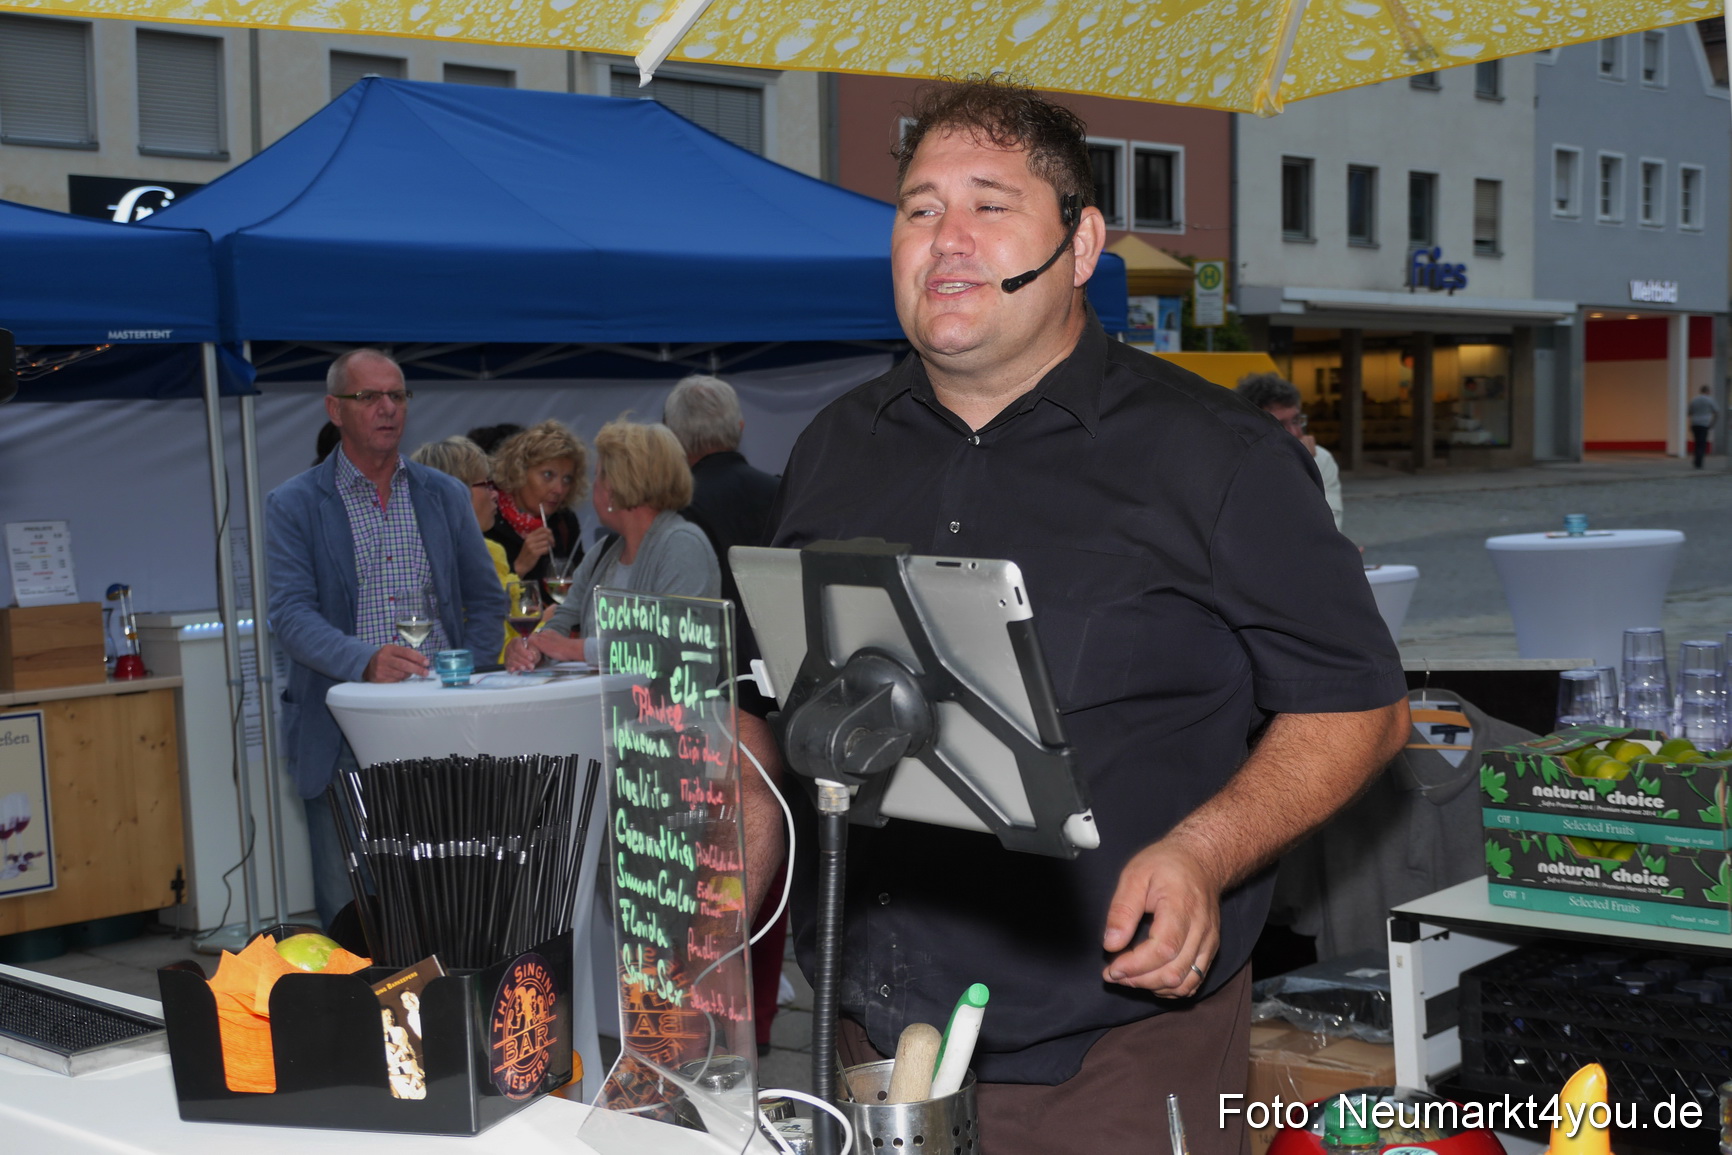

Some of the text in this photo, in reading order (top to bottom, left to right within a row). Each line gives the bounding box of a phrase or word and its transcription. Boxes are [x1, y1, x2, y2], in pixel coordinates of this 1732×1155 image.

[1411, 246, 1468, 290] fries
[108, 330, 173, 340] MASTERTENT
[598, 596, 670, 638] Cocktails
[613, 706, 671, 760] Ipanema
[1532, 785, 1666, 809] natural choice
[615, 808, 666, 863] Coconut
[1515, 816, 1520, 825] 1
[1563, 818, 1635, 837] Selected Fruits
[1537, 861, 1671, 887] natural choice
[1521, 891, 1526, 900] 1
[1569, 896, 1641, 914] Selected Fruits
[619, 898, 669, 949] Florida
[493, 962, 556, 1033] THE SINGING
[656, 959, 684, 1008] Sex
[504, 1023, 549, 1062] BAR
[504, 1049, 550, 1091] KEEPERS
